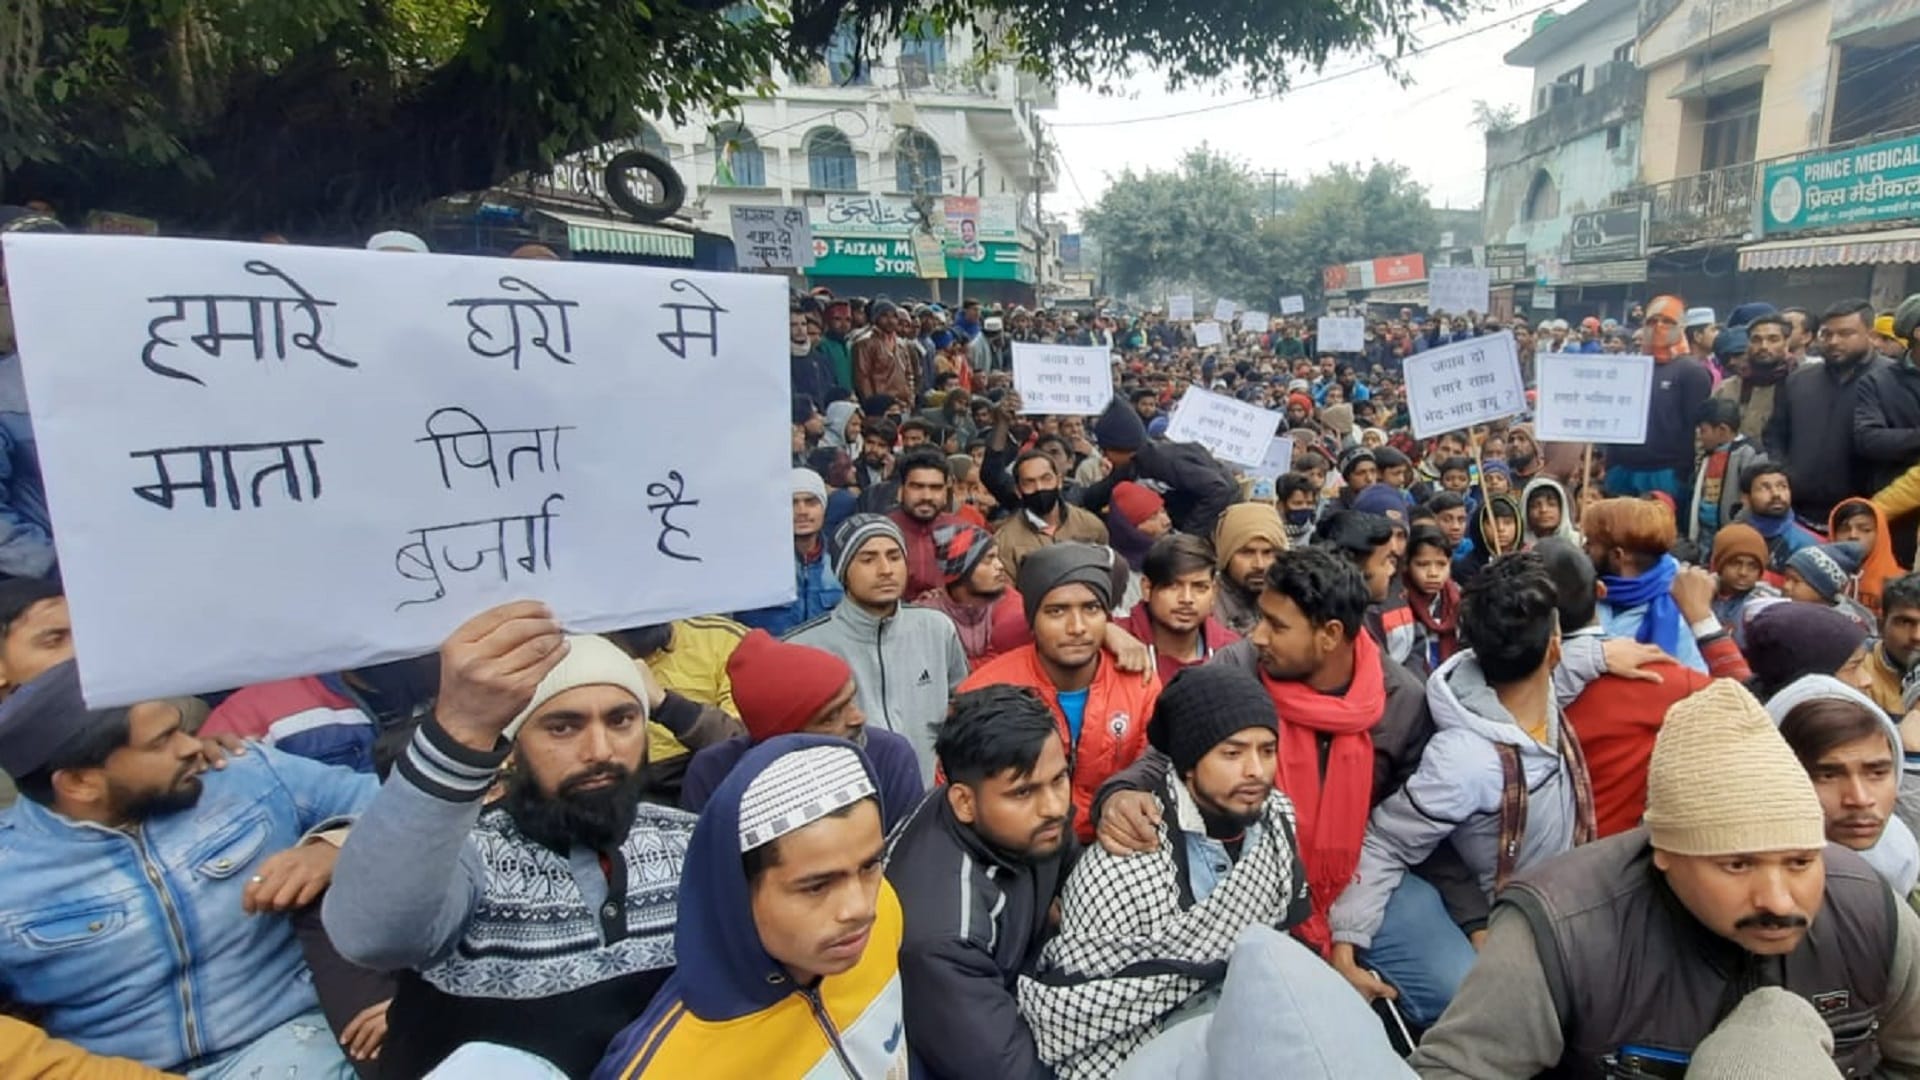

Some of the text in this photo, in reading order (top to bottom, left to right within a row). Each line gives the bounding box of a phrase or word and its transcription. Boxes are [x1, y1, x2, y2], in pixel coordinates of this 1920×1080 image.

[1804, 144, 1920, 182] PRINCE MEDICAL
[834, 240, 888, 256] FAIZAN
[142, 260, 730, 387] हमारे घरो मे
[1430, 349, 1485, 372] जवाब दो
[1432, 372, 1496, 398] हमारे साथ
[130, 407, 577, 510] माता पिता
[647, 470, 703, 562] है
